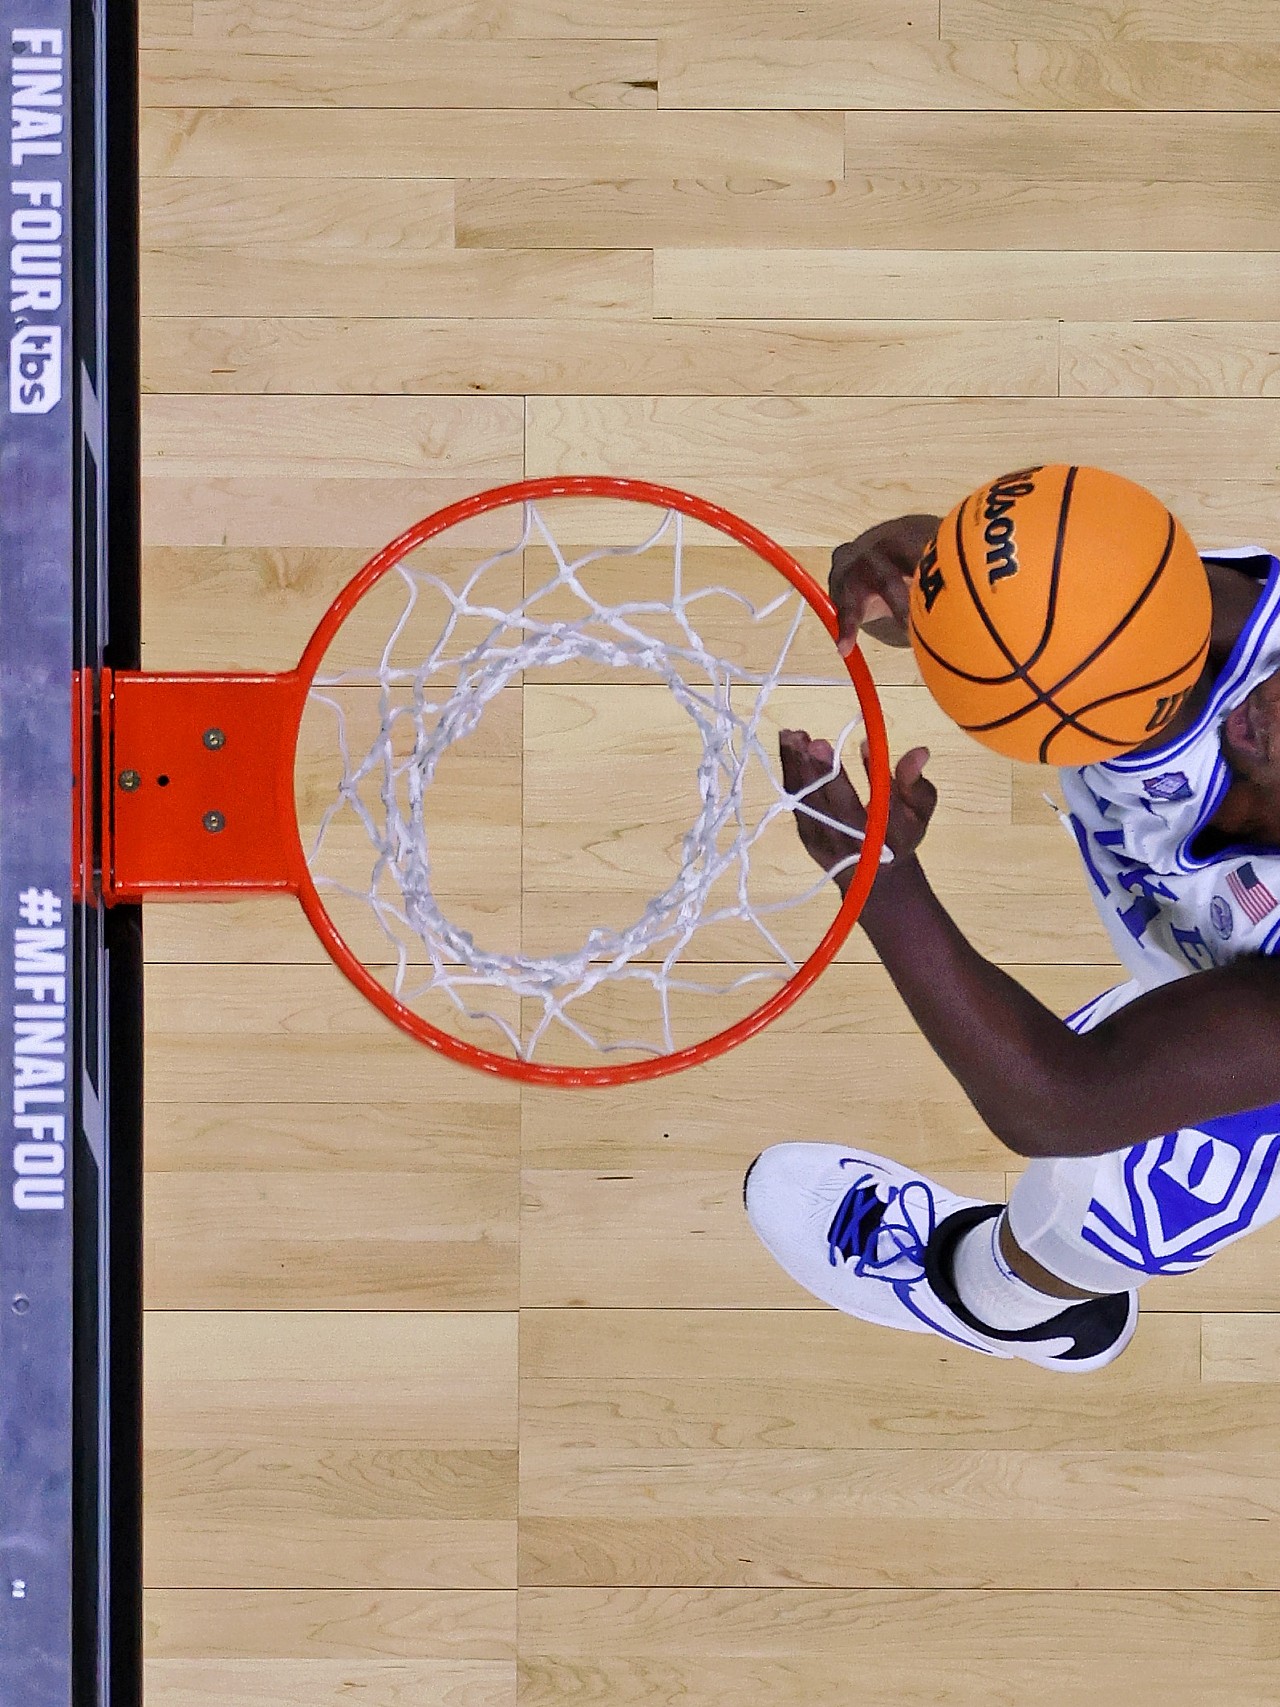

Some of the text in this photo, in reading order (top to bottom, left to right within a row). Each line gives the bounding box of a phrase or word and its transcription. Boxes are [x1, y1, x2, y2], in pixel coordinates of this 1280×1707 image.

[11, 29, 62, 311] FINAL FOUR
[18, 334, 54, 408] tbs
[13, 887, 65, 1208] #MFINALFOU
